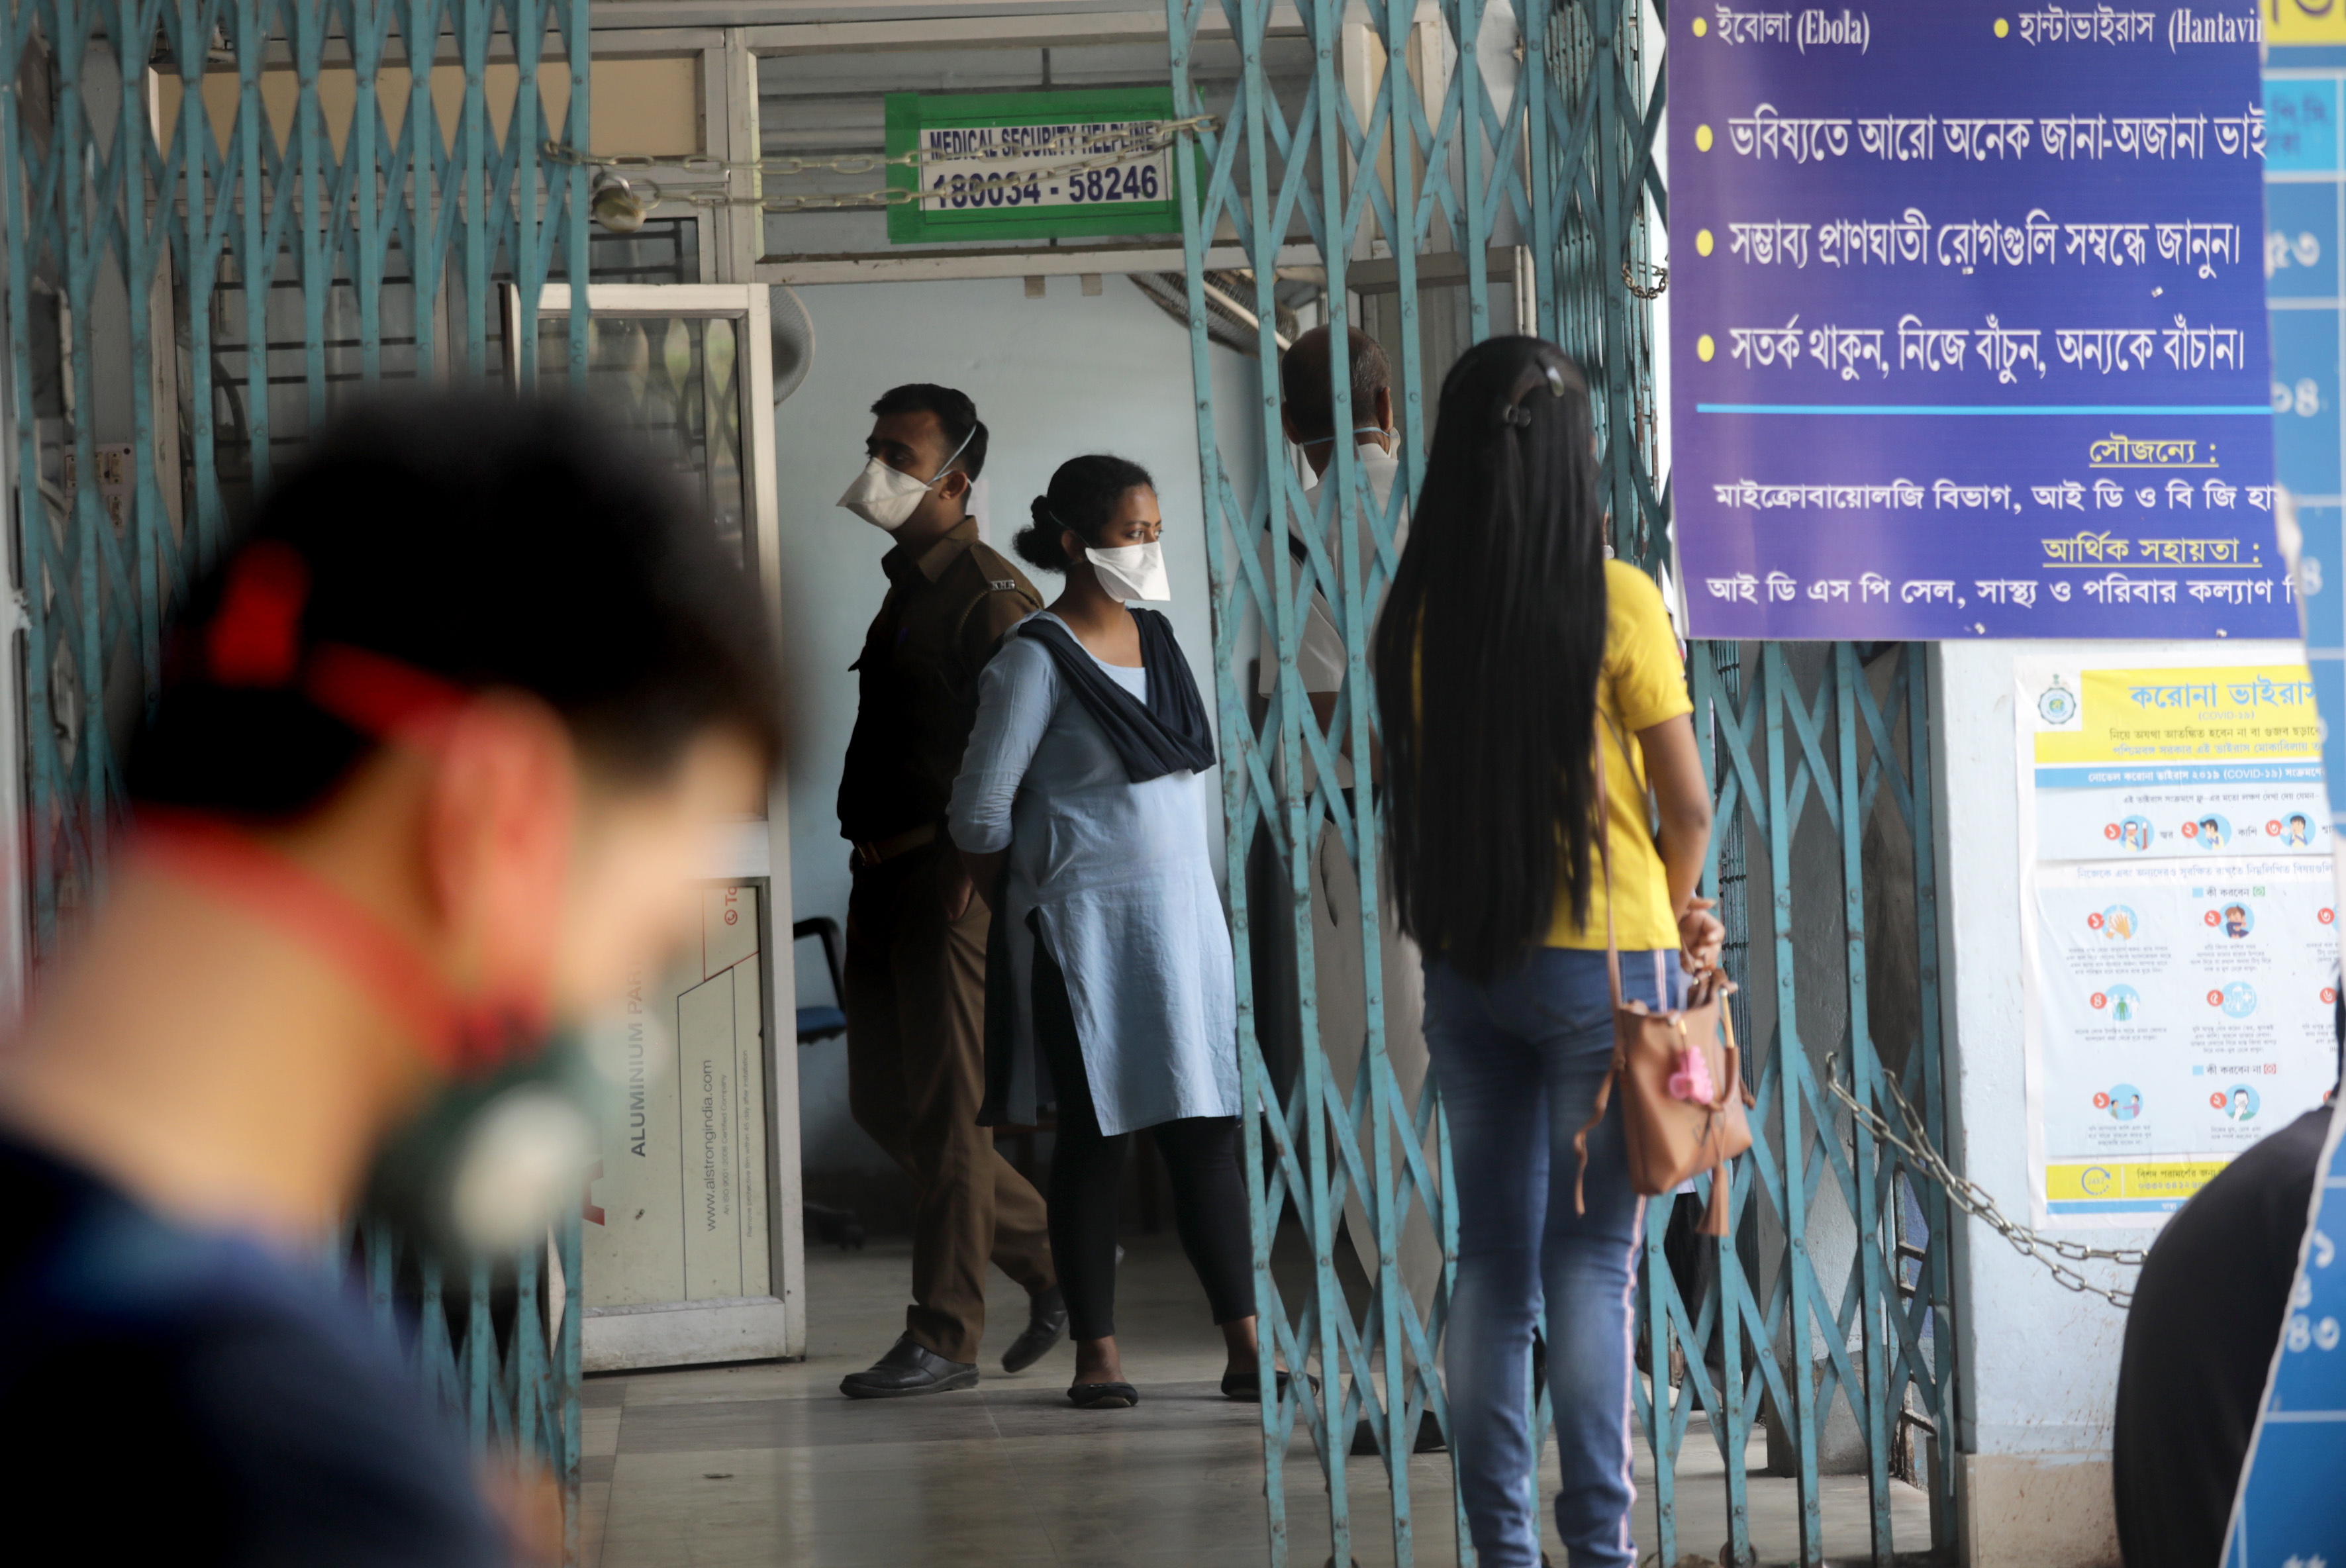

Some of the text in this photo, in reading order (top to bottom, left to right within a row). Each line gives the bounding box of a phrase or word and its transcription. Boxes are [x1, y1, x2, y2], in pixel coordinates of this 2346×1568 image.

[1716, 4, 1869, 54] ইবোলা (Ebola)
[2019, 3, 2155, 45] হান্টাভাইরাস
[930, 121, 1155, 160] MEDICAL SECURITY HELPLINE
[1728, 103, 1851, 164] ভবিষ্যতে
[1858, 115, 1937, 160] আরো
[1943, 119, 2033, 161] অনেক
[2039, 113, 2207, 160] জানা-অজানা
[934, 172, 1041, 209] 180034
[1069, 165, 1159, 203] 58246
[1729, 208, 2239, 279] সম্ভাব্য প্রাণঘাতী রোগগুলি সম্বন্ধে জানুন।
[1730, 314, 2243, 383] সতর্ক থাকুন, নিজে বাঁচুন, অন্যকে বাঁচান।
[2090, 432, 2197, 463] সৌজন্যে
[1714, 479, 1924, 509] মাইক্রোবায়োলজি
[1932, 479, 2021, 514] বিভাগ,
[2031, 480, 2086, 511] আই
[2093, 479, 2124, 509] ডি
[2135, 488, 2155, 507] ও
[2165, 479, 2194, 509] বি
[2202, 479, 2237, 509] জি
[2042, 532, 2129, 562] আর্থিক
[2139, 538, 2240, 564] সহায়তা
[1706, 572, 1759, 603] আই
[1766, 571, 1796, 601] ডি
[1808, 581, 1851, 602] এস
[1859, 572, 1890, 603] পি
[1901, 581, 1965, 609] সেল,
[2050, 582, 2071, 601] ও
[2083, 573, 2177, 603] পরিবার
[2186, 579, 2273, 604] কল্যাণ
[2127, 681, 2218, 709] করোনা
[628, 1023, 646, 1158] ALUMINIUM
[703, 1059, 716, 1232] www.alstrongindia.com
